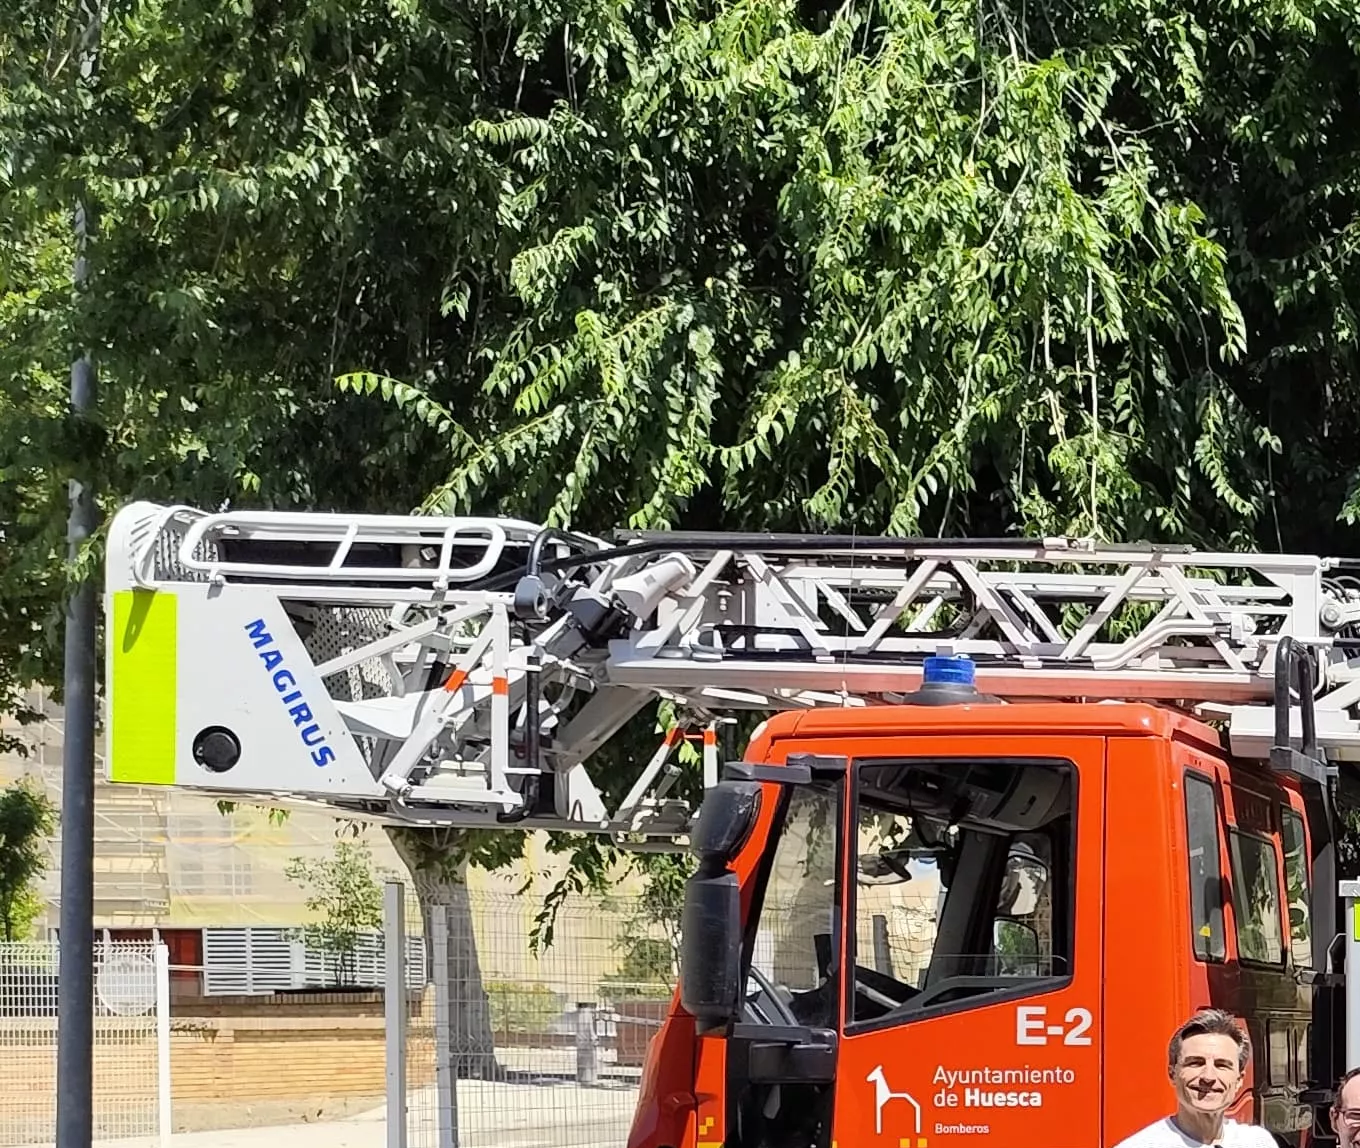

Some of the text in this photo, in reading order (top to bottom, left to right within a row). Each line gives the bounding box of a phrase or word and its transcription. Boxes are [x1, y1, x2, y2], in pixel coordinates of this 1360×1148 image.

[244, 618, 336, 768] MAGIRUS
[1016, 1005, 1093, 1046] E-2
[932, 1065, 1076, 1089] Ayuntamiento
[933, 1087, 1043, 1108] de Huesca
[934, 1122, 990, 1135] Bomberos
